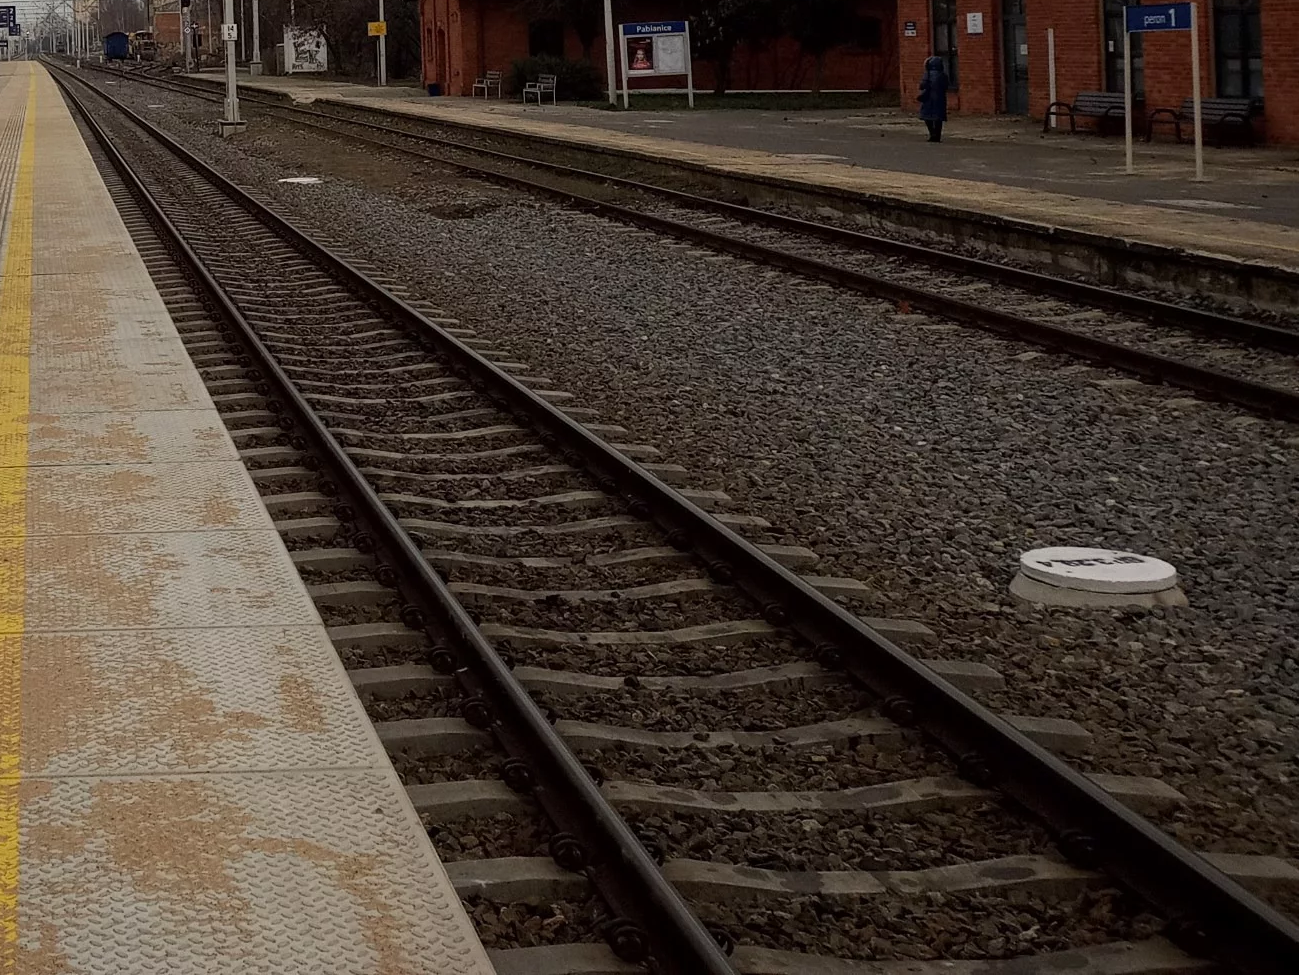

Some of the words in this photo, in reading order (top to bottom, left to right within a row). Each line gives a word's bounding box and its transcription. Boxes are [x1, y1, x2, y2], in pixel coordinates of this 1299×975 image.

[1144, 15, 1166, 27] peron
[1168, 8, 1176, 27] 1
[636, 25, 672, 33] Pabianice
